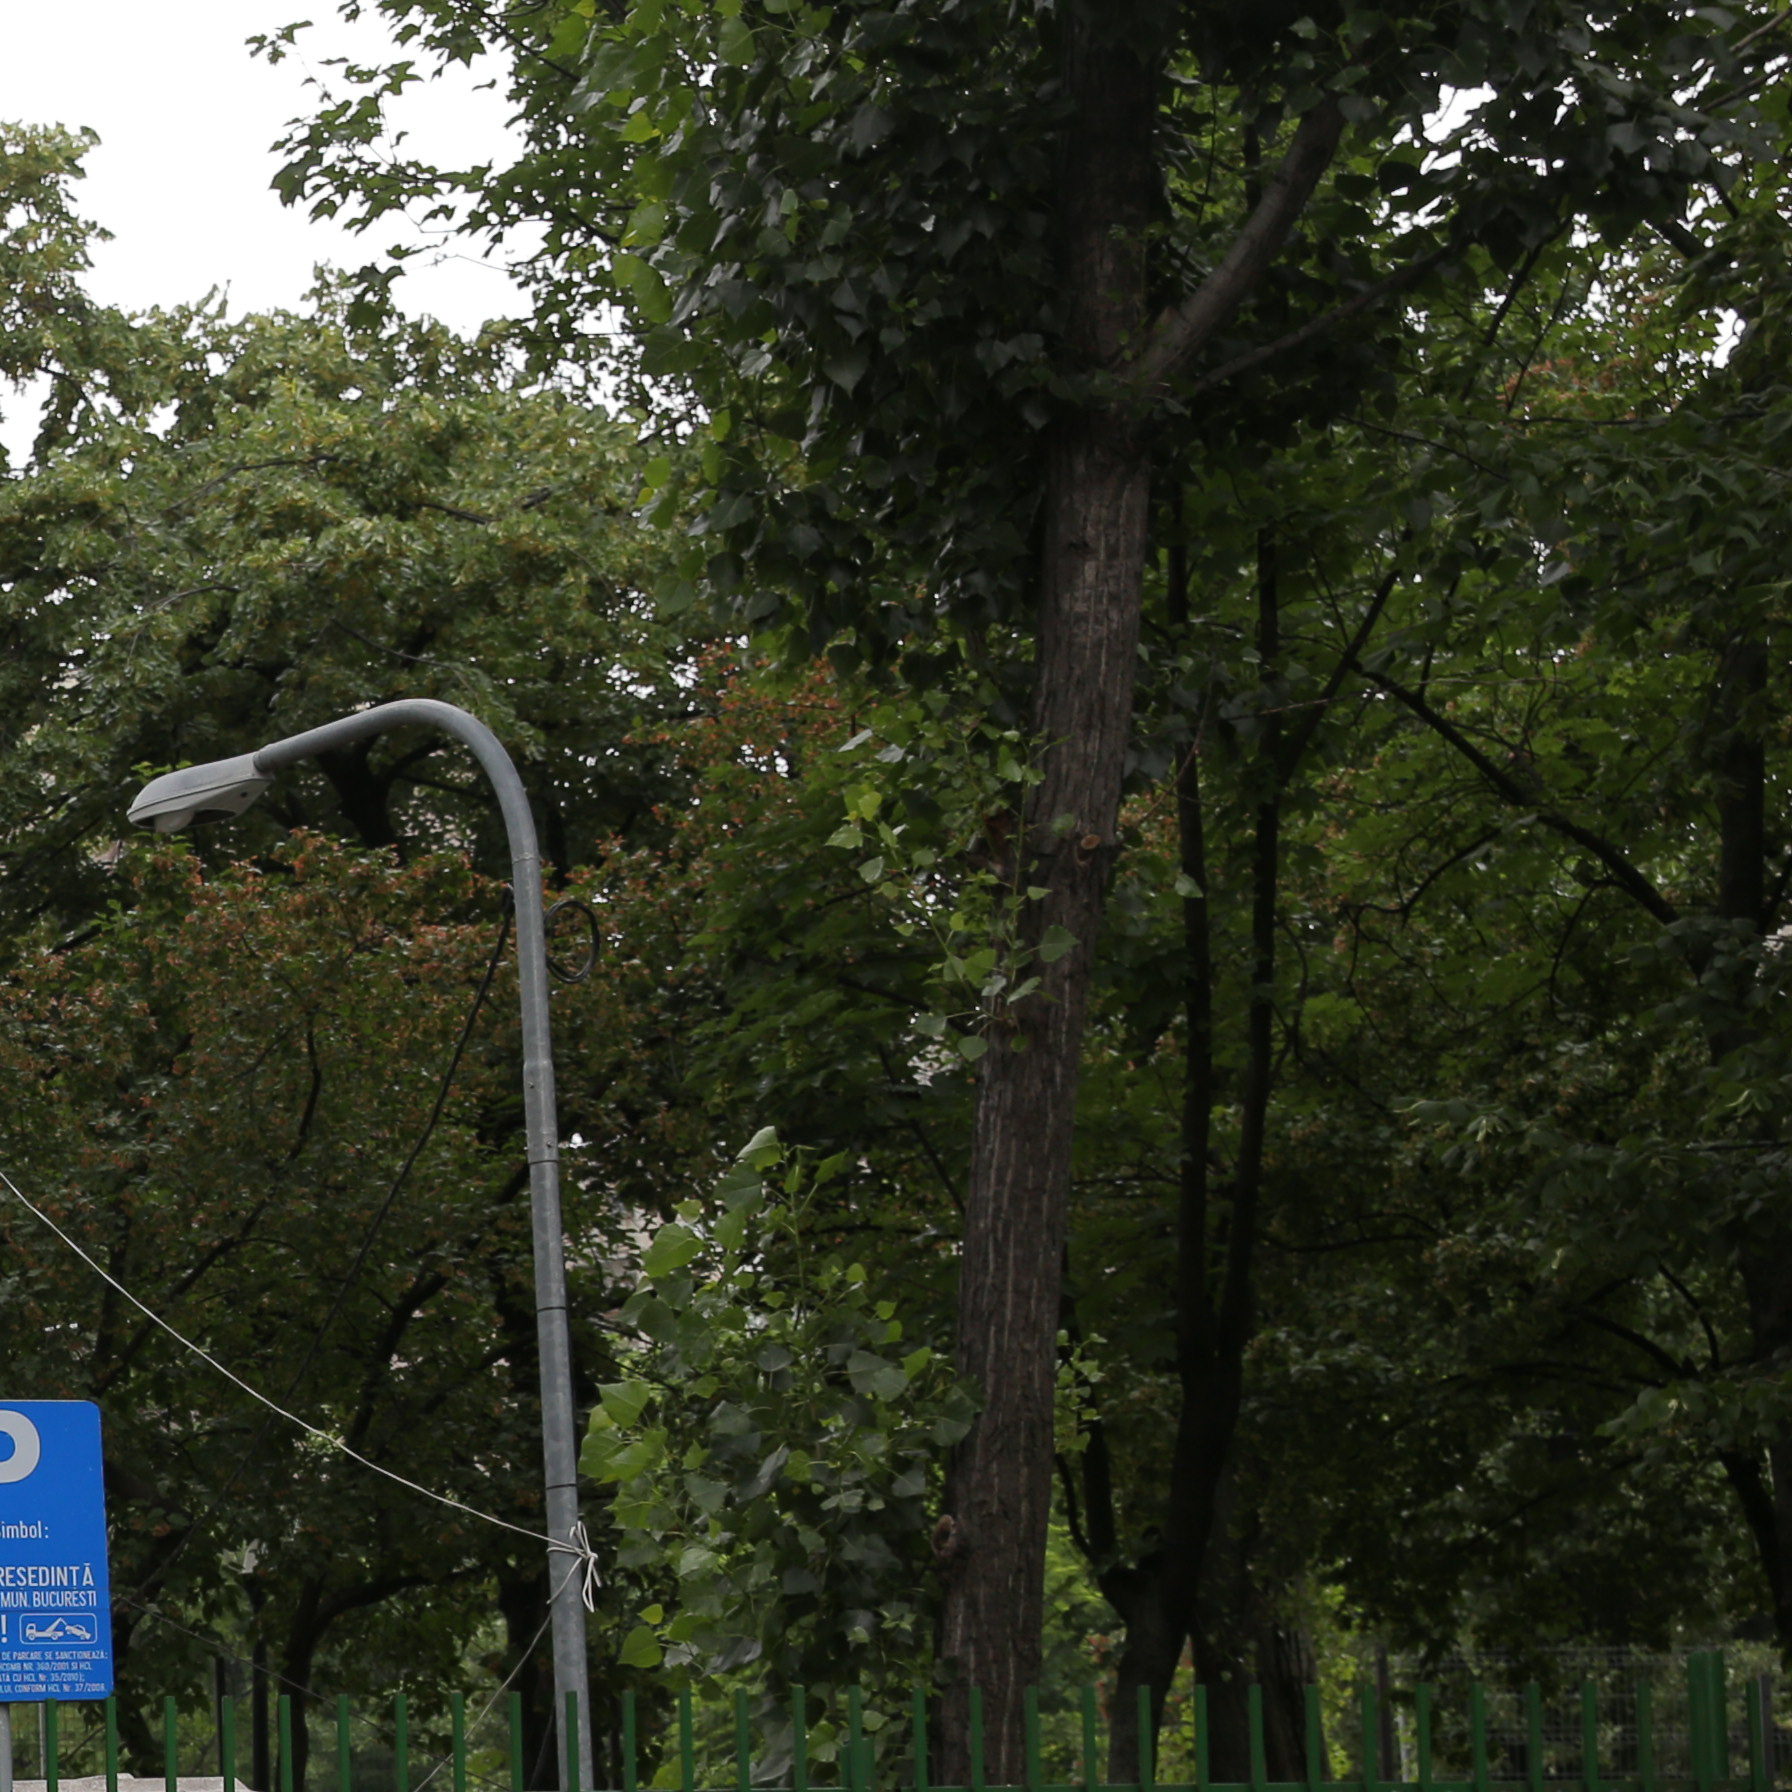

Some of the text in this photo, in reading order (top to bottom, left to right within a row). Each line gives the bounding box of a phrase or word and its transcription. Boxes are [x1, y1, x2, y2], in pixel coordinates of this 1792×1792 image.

[0, 1591, 31, 1608] MUN.
[1, 1651, 11, 1660] DE
[13, 1651, 43, 1660] PARCARE
[44, 1651, 53, 1660] SE
